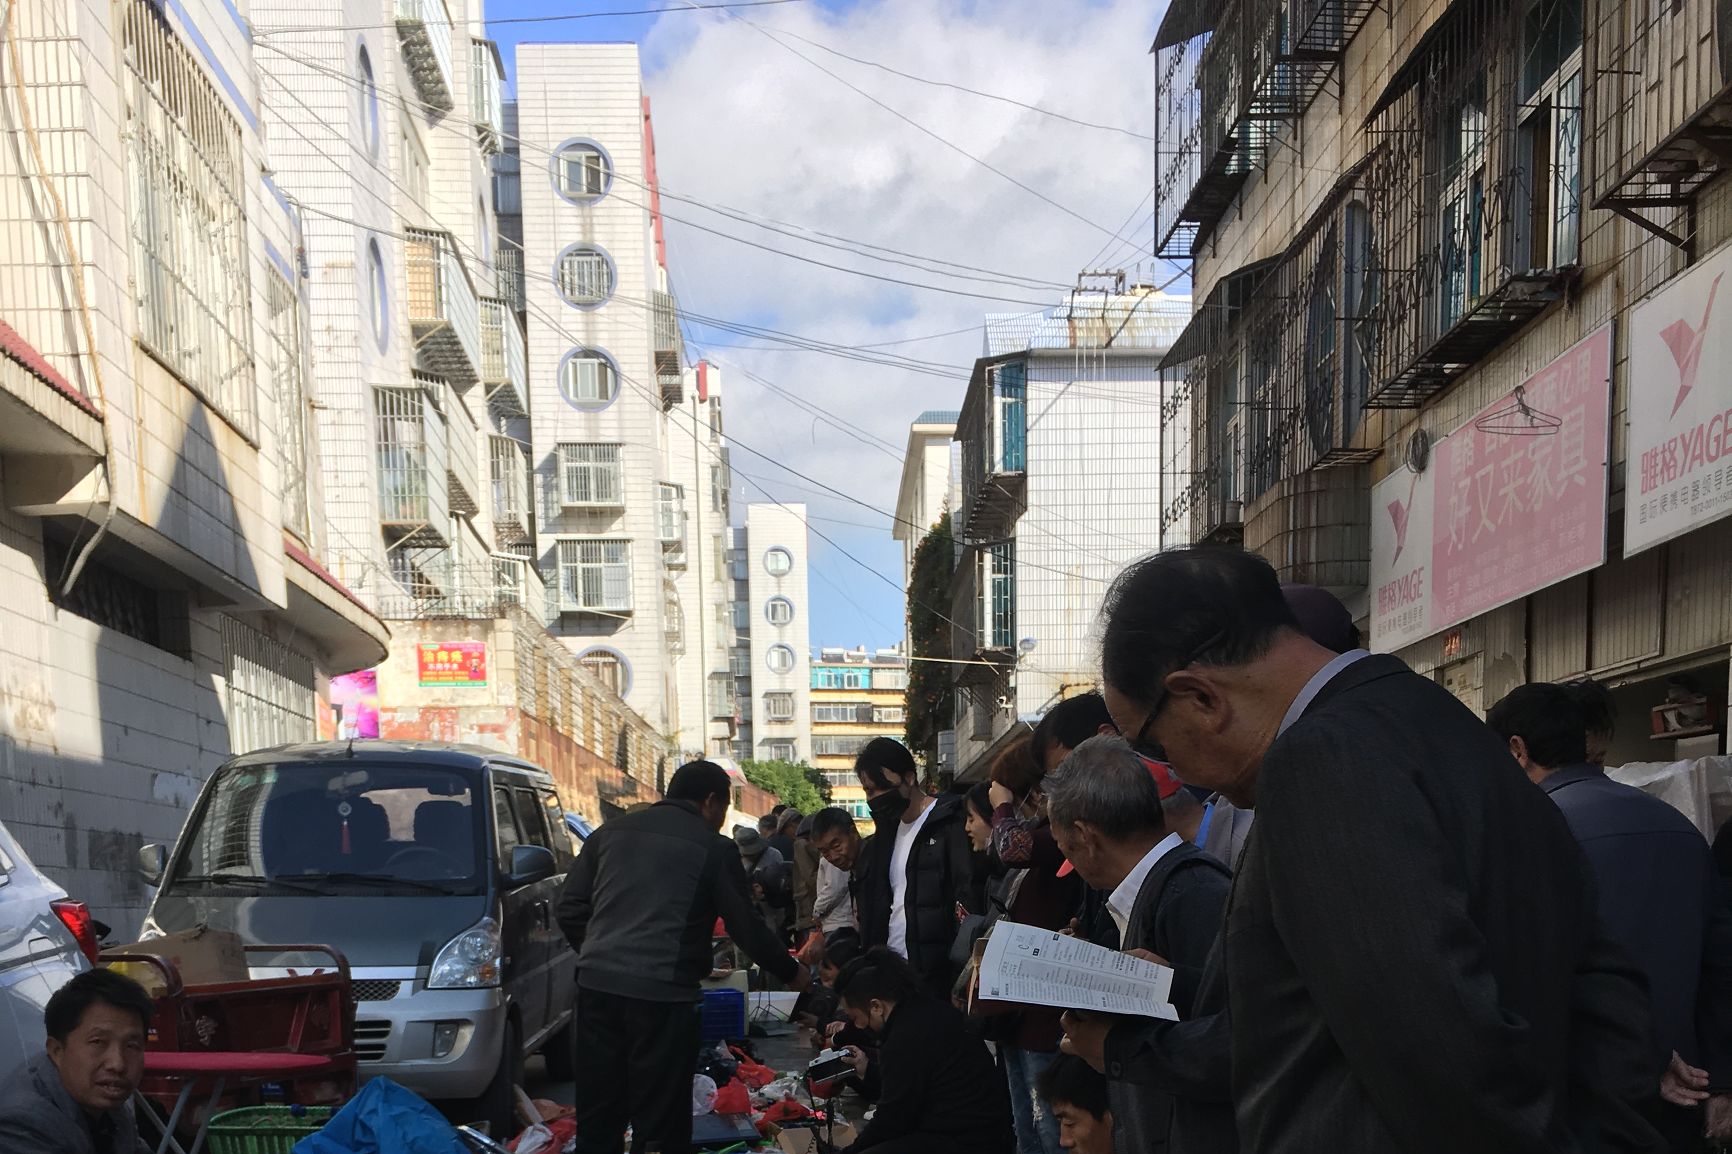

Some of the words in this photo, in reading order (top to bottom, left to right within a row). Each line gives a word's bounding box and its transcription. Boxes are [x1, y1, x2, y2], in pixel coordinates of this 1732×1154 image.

[1446, 408, 1587, 557] 好又来家具
